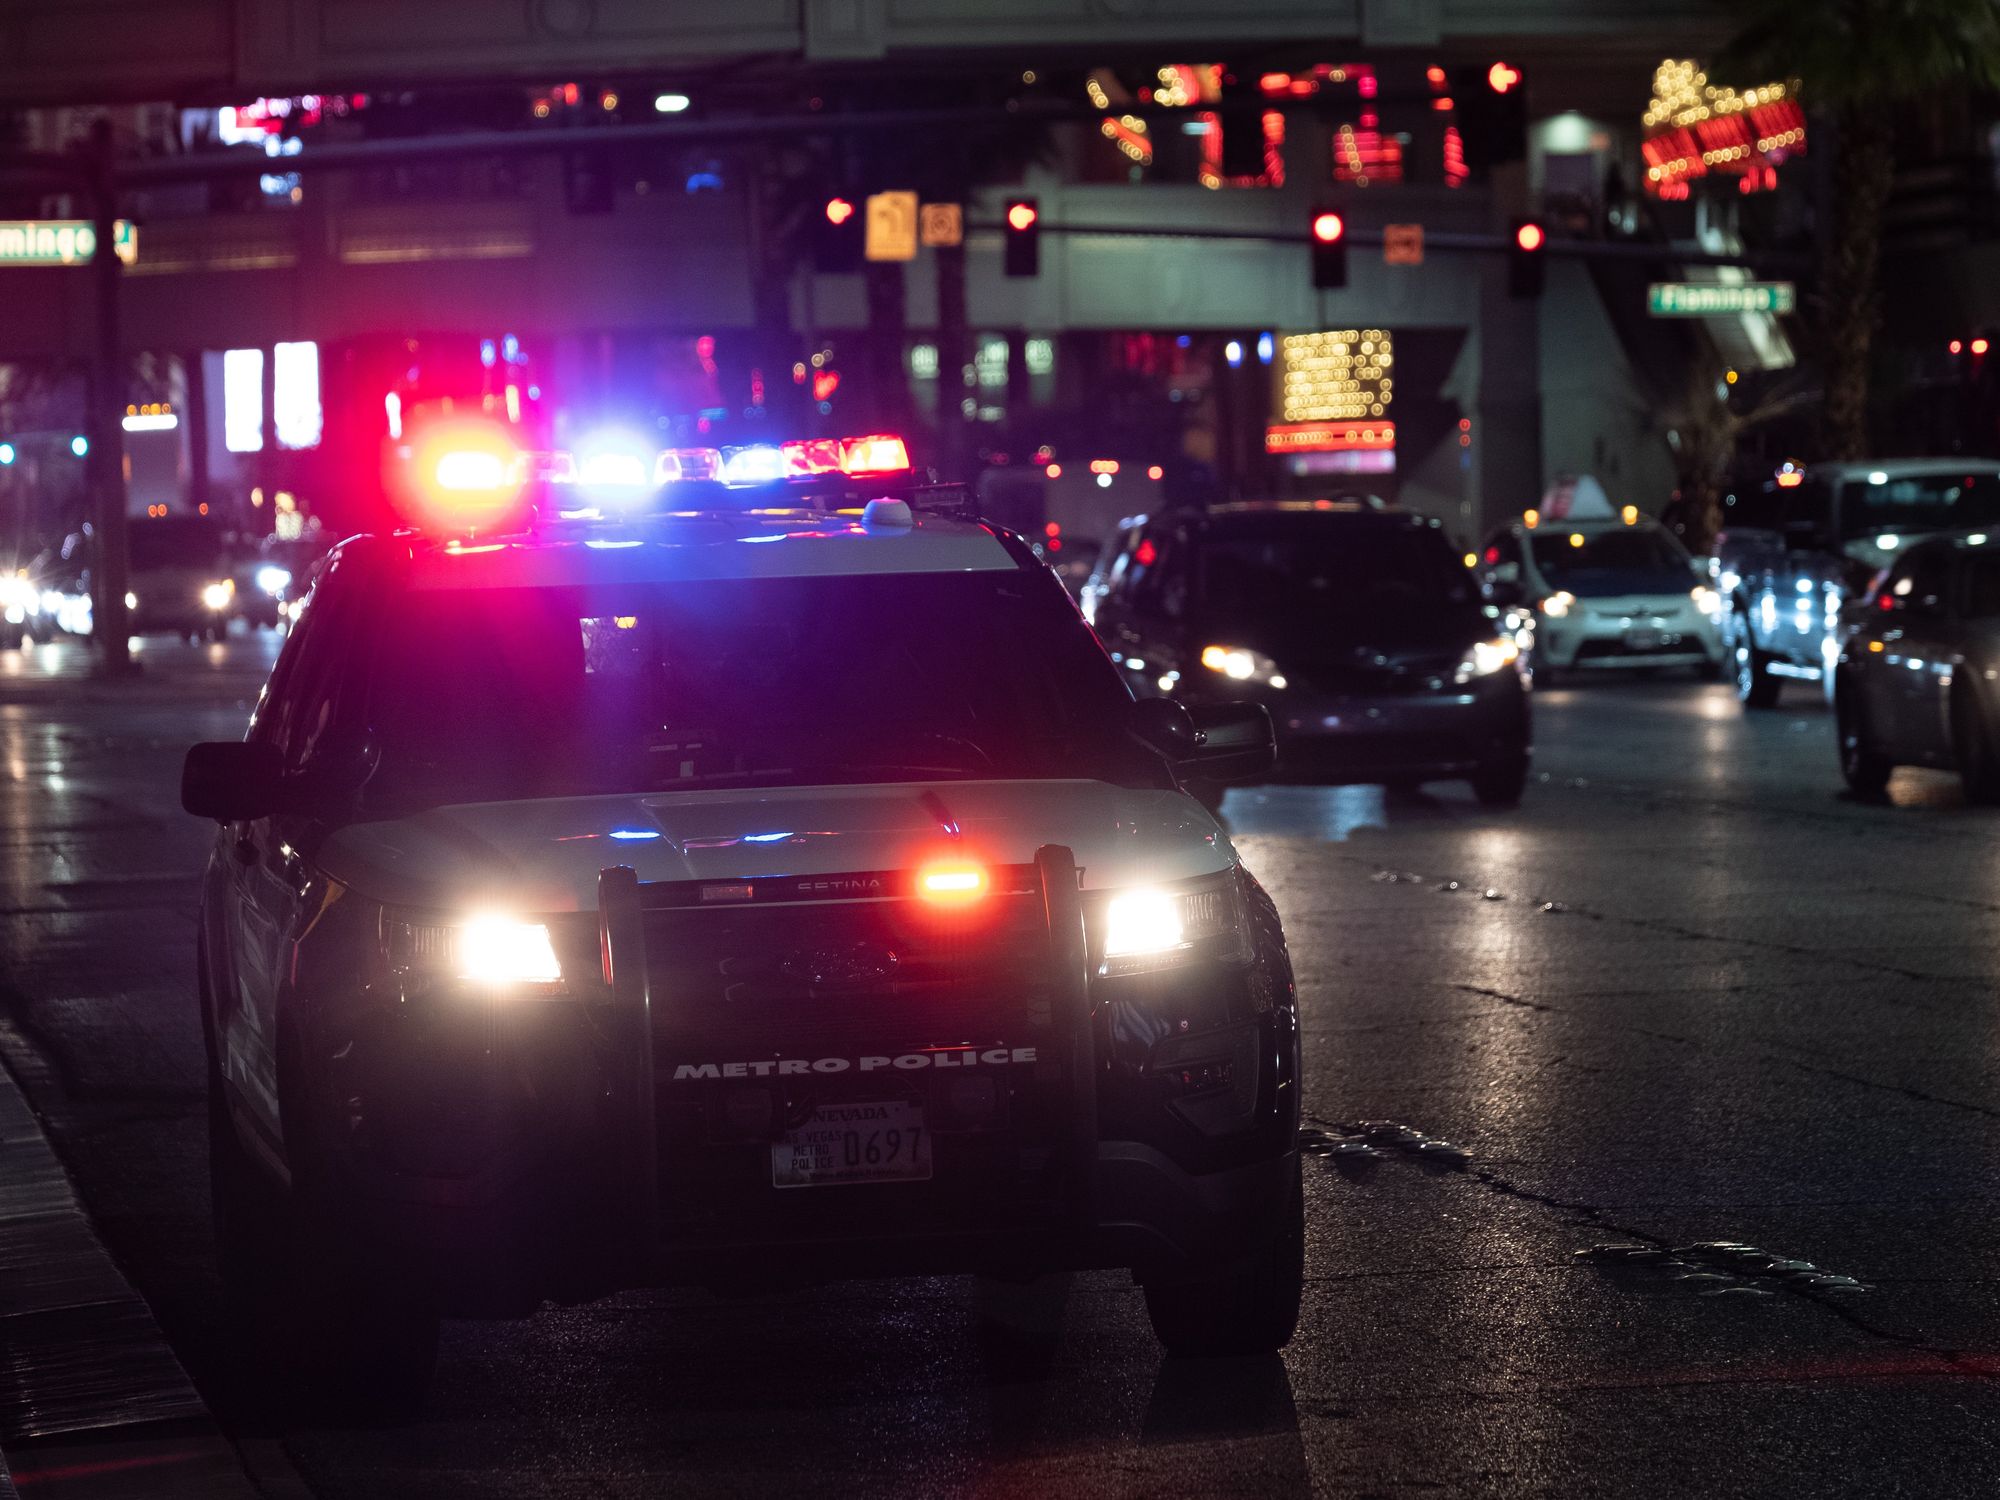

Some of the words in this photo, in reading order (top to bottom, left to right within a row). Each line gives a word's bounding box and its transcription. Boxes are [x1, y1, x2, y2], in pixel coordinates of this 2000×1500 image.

[672, 1057, 850, 1080] METRO
[859, 1047, 1037, 1072] POLICE
[814, 1107, 888, 1123] NEVADA
[807, 1129, 842, 1143] VEGAS
[793, 1143, 830, 1157] METRO
[844, 1126, 922, 1166] 0697
[791, 1156, 834, 1171] POLICE
